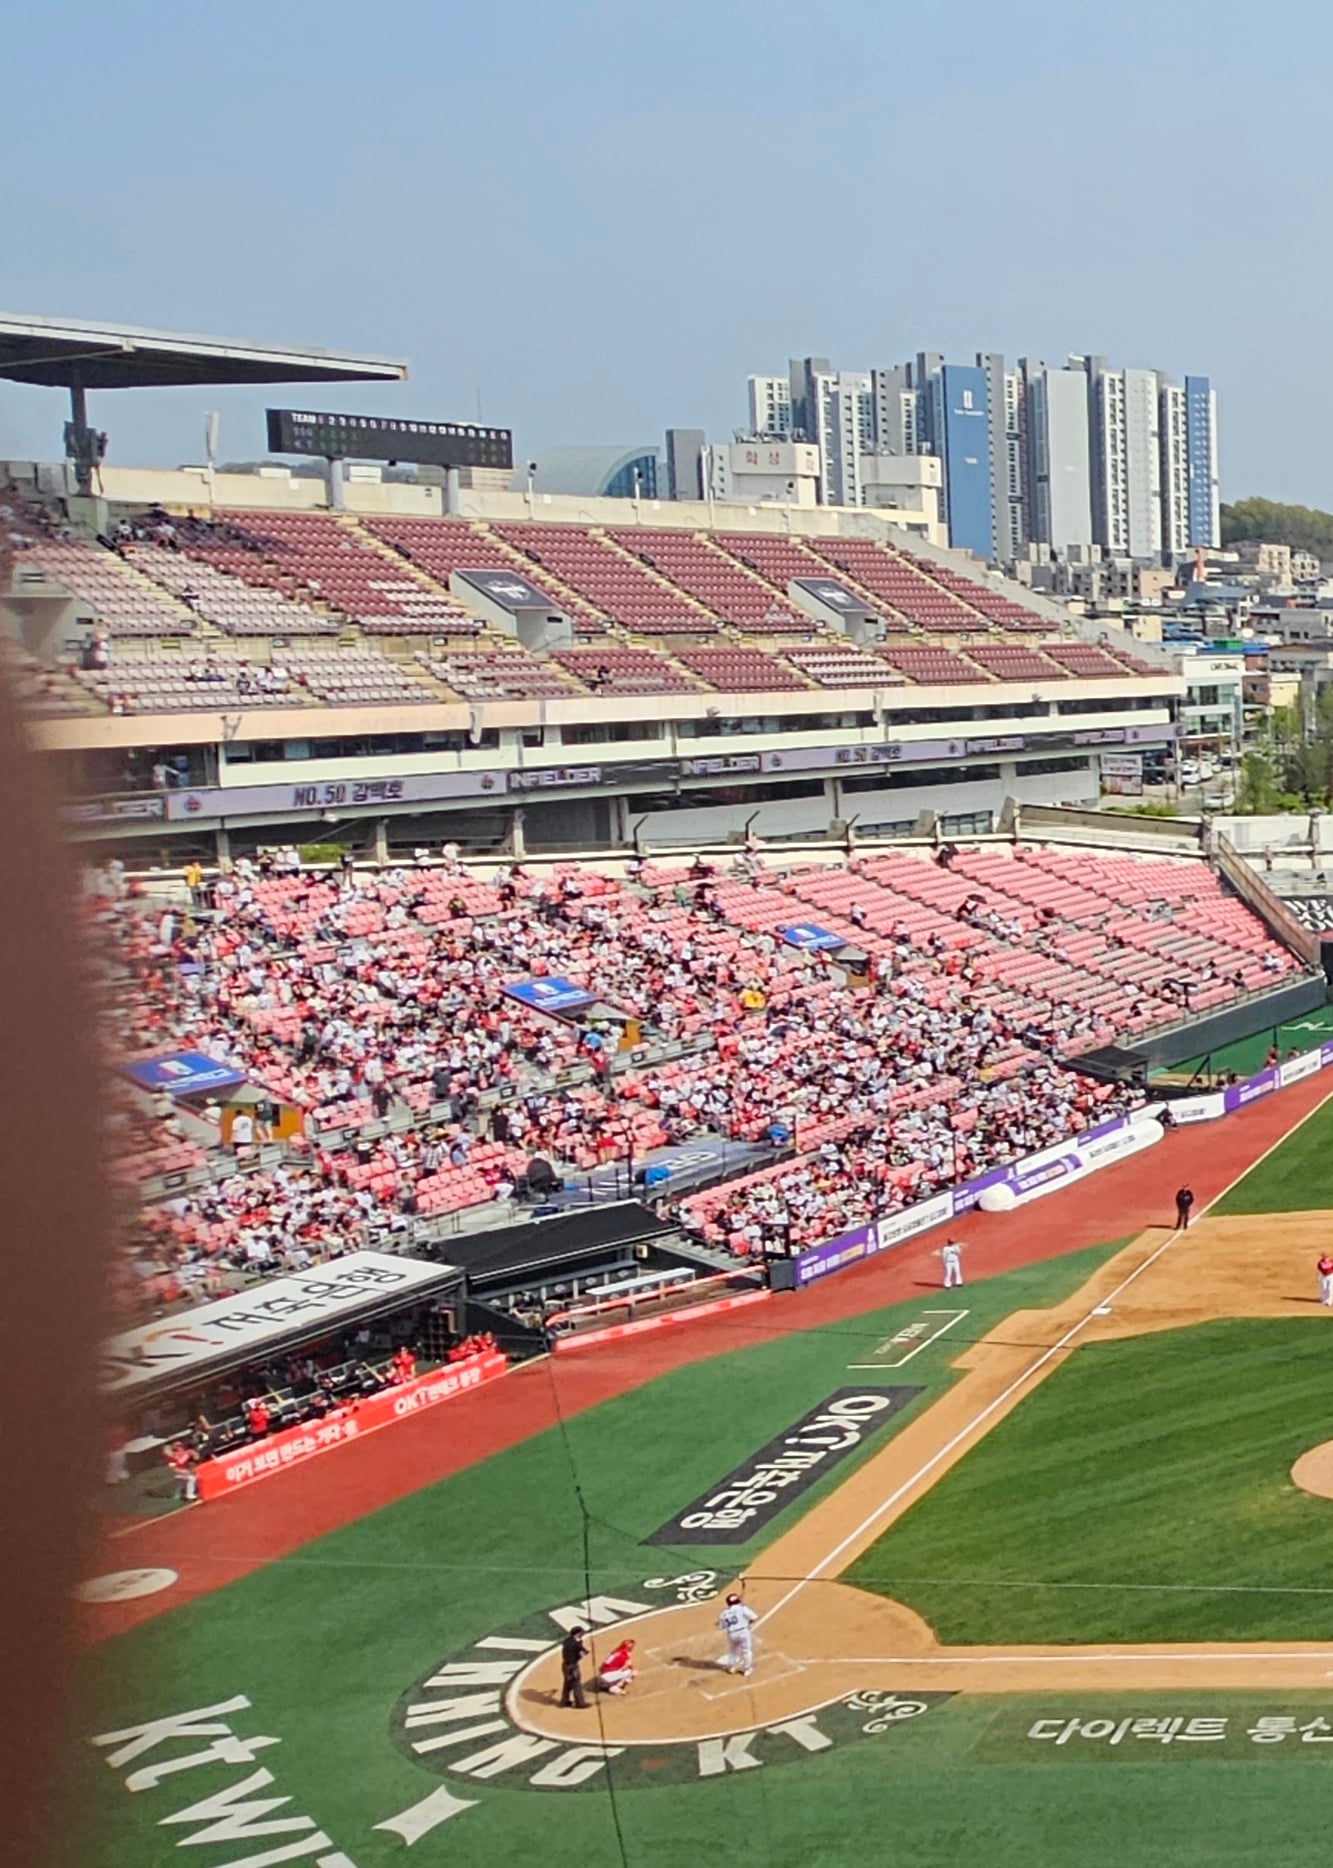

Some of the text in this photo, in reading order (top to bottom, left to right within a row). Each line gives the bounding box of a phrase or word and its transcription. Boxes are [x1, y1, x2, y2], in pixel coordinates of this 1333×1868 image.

[294, 783, 347, 808] NO.50
[510, 767, 600, 788] INFIELDER
[201, 1265, 408, 1331] 저축은행
[680, 1450, 827, 1530] 저축은행
[404, 1596, 834, 1786] WINNING KT
[1027, 1717, 1228, 1746] 다이렉트
[91, 1694, 357, 1868] ktwi
